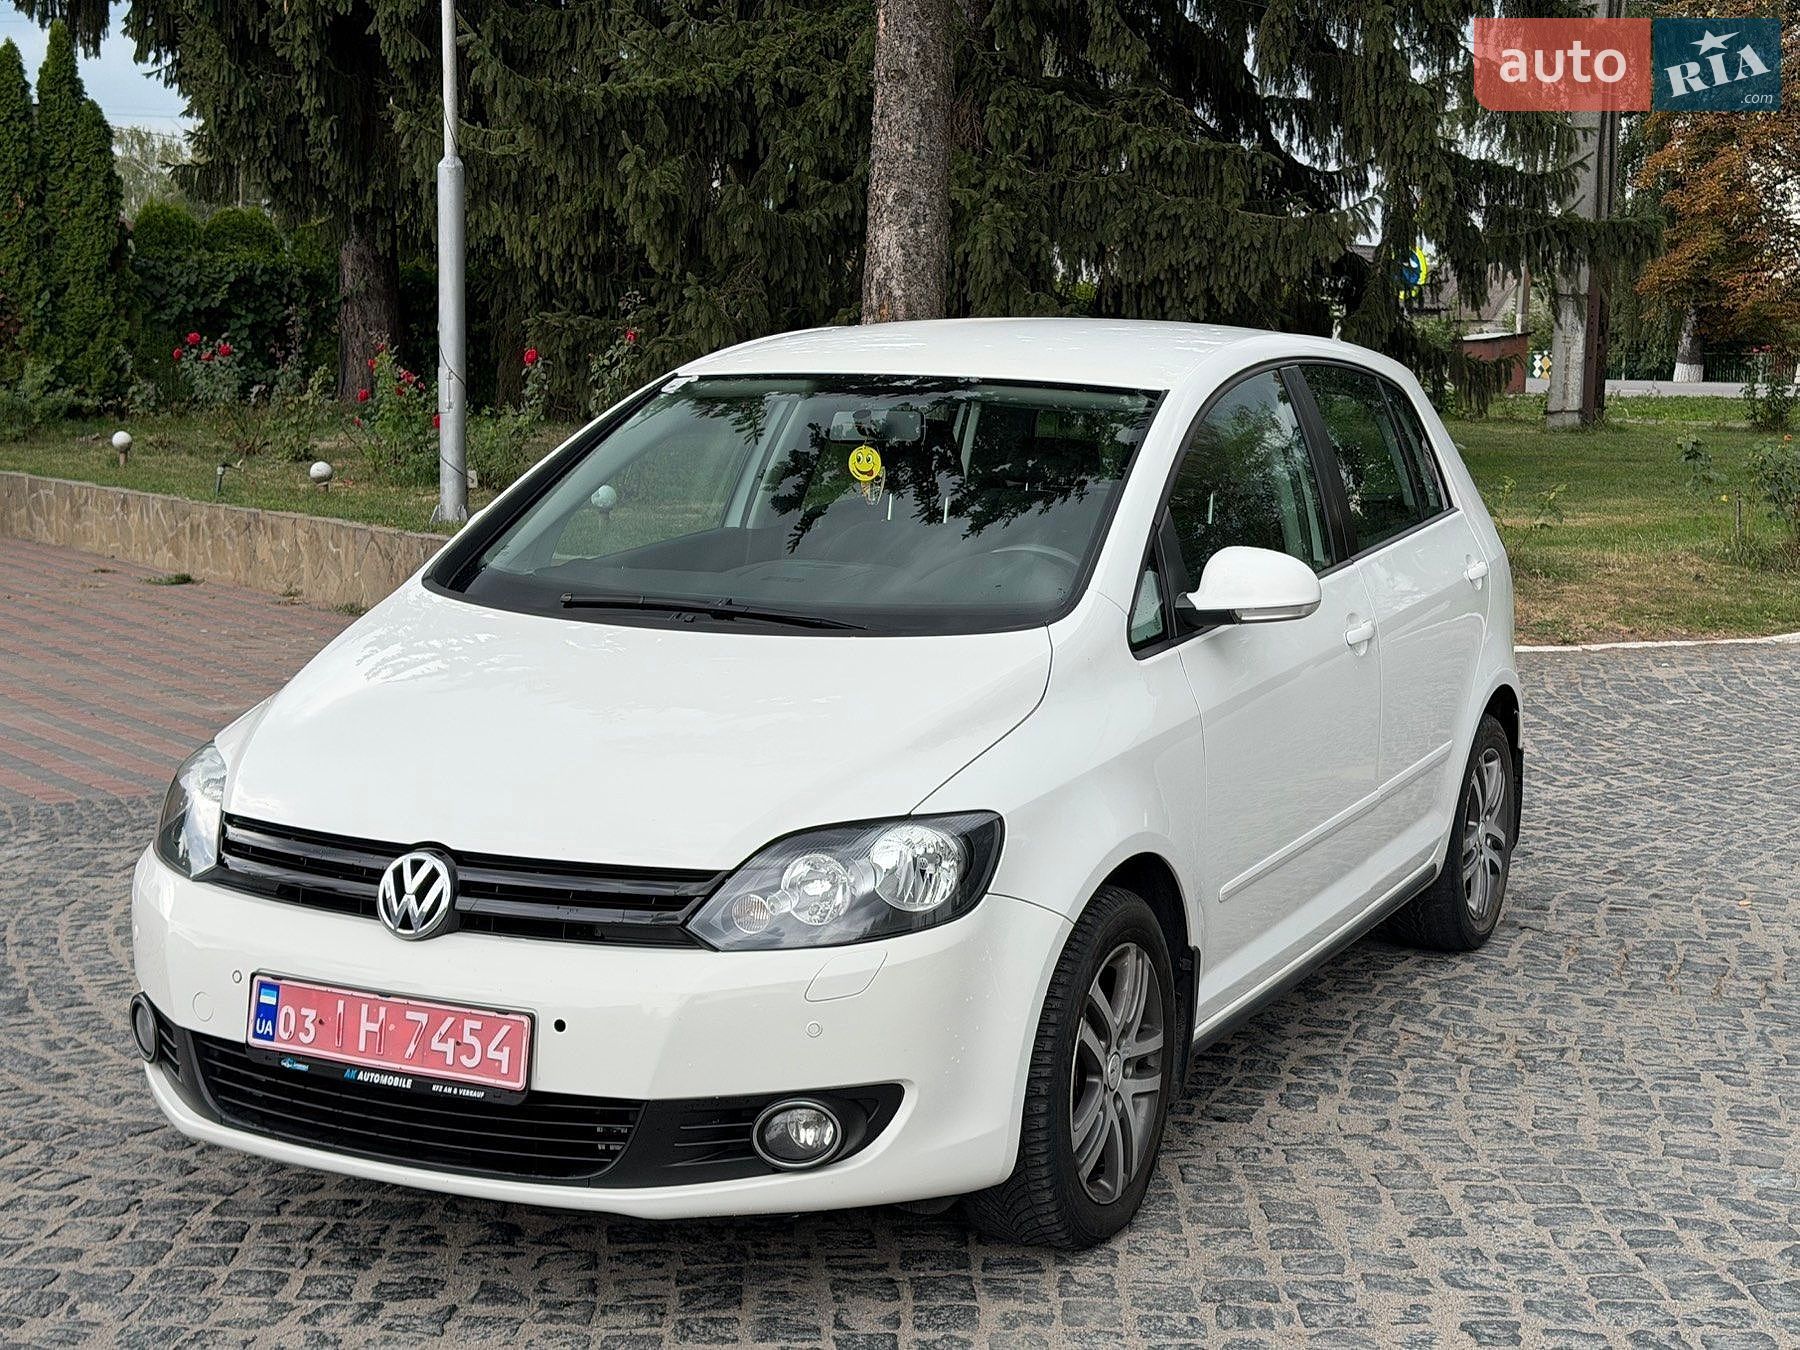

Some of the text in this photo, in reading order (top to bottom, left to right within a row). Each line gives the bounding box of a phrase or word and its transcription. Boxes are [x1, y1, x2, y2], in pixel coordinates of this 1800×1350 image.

[256, 1018, 274, 1036] UA
[278, 999, 511, 1074] 03 IH 7454
[357, 1070, 413, 1089] AUTOMOBILE
